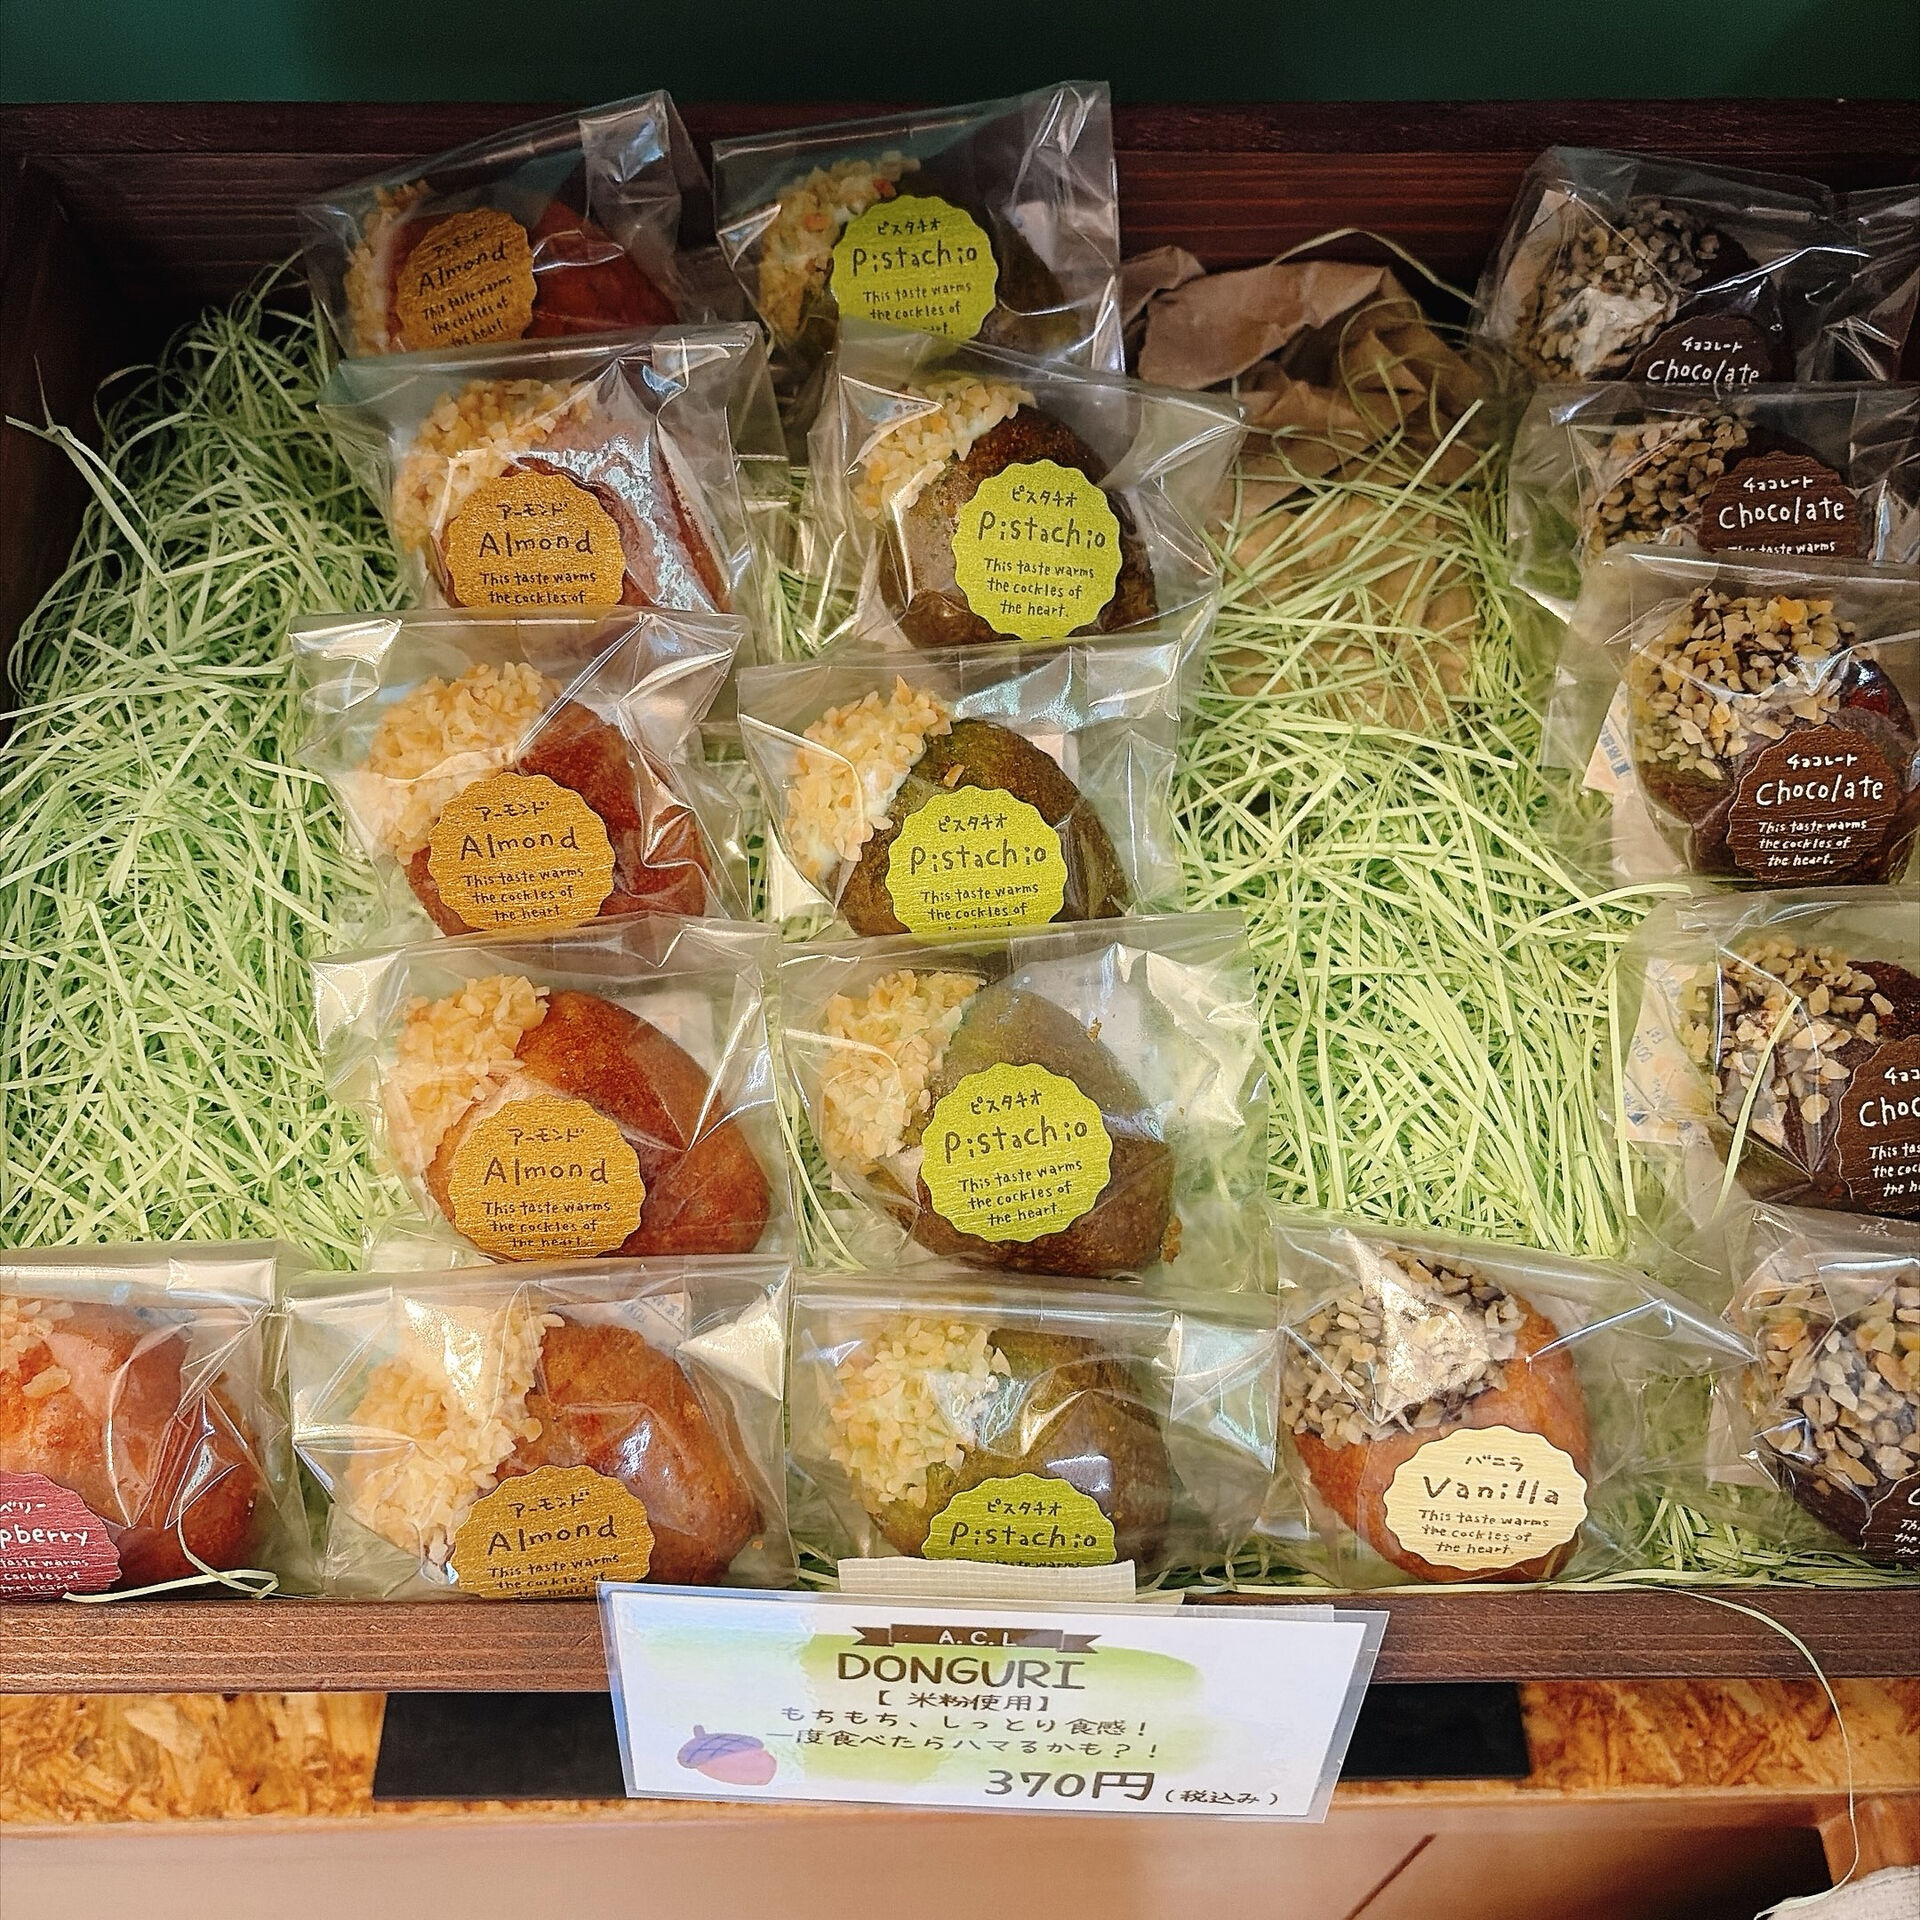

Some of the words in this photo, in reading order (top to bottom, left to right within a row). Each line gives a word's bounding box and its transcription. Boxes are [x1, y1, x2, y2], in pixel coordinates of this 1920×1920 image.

[853, 240, 977, 276] Pistachio
[419, 241, 507, 296] Almond
[863, 291, 890, 304] This
[896, 286, 927, 301] taste
[931, 282, 971, 294] warms
[870, 308, 891, 320] the
[896, 304, 944, 319] cockles
[949, 300, 960, 314] of
[1647, 359, 1760, 384] Chocolate
[1012, 485, 1078, 508] ピスタチオ
[1719, 497, 1846, 529] Chocolate
[978, 511, 1106, 549] Pistachio
[479, 530, 593, 558] Almond
[1796, 541, 1835, 554] warms
[984, 558, 1012, 572] This
[1017, 560, 1050, 576] taste
[1055, 566, 1095, 578] warms
[480, 572, 510, 586] This
[514, 572, 548, 585] taste
[552, 572, 597, 582] warms
[987, 577, 1009, 593] the
[1013, 583, 1063, 598] cockles
[1069, 586, 1082, 599] of
[488, 591, 510, 604] the
[515, 591, 568, 603] cockles
[572, 590, 586, 603] of
[1000, 600, 1022, 614] the
[1028, 603, 1068, 617] heart.
[1787, 754, 1858, 770] チョコレート
[1756, 774, 1884, 806] Chocolate
[475, 801, 550, 821] アーモンド
[939, 813, 1008, 832] ピスタチオ
[1758, 822, 1785, 833] This
[1790, 821, 1823, 833] taste
[1827, 821, 1868, 830] warms
[460, 826, 580, 860] Almond
[1759, 839, 1782, 849] the
[1782, 839, 1831, 848] cockles
[1836, 837, 1851, 849] of
[910, 839, 1047, 875] Pistachio
[1767, 855, 1789, 867] the
[1793, 854, 1834, 865] heart.
[463, 875, 494, 887] This
[500, 871, 535, 885] taste
[540, 868, 584, 880] warms
[472, 892, 496, 904] the
[500, 889, 555, 902] cockles
[560, 885, 574, 898] of
[921, 891, 950, 904] This
[955, 887, 991, 901] taste
[995, 884, 1039, 897] warms
[928, 909, 951, 921] the
[956, 905, 1008, 919] cockles
[1014, 902, 1028, 915] of
[971, 1089, 1043, 1114] ピスタチオ
[507, 1128, 584, 1146] アーモンド
[945, 1115, 1088, 1164] Pistachio
[1869, 1145, 1897, 1160] This
[483, 1157, 609, 1185] Almond
[958, 1179, 990, 1193] This
[994, 1169, 1032, 1187] taste
[1037, 1160, 1082, 1178] warms
[1872, 1165, 1894, 1178] the
[968, 1197, 992, 1210] the
[997, 1187, 1052, 1206] cockles
[1058, 1181, 1072, 1194] of
[1882, 1183, 1904, 1197] the
[481, 1201, 515, 1216] This
[520, 1202, 558, 1215] taste
[563, 1203, 610, 1213] warms
[987, 1214, 1011, 1226] the
[1017, 1203, 1063, 1221] heart.
[490, 1221, 515, 1232] the
[520, 1221, 577, 1232] cockles
[584, 1219, 598, 1231] of
[1465, 1455, 1524, 1472] バニラ
[1424, 1476, 1560, 1505] Vanilla
[508, 1492, 590, 1518] アーモンド
[987, 1498, 1062, 1517] ピスタチオ
[1419, 1509, 1451, 1521] This
[1457, 1512, 1496, 1524] taste
[1501, 1517, 1549, 1527] warms
[487, 1515, 618, 1556] Almond
[950, 1522, 1096, 1548] Pistachio
[1421, 1525, 1446, 1535] the
[1452, 1530, 1510, 1541] cockles
[1515, 1532, 1532, 1543] of
[1436, 1542, 1460, 1552] the
[1467, 1544, 1514, 1554] heart.
[4, 1572, 63, 1581] cockles
[66, 1571, 81, 1580] of
[488, 1567, 522, 1578] This
[528, 1560, 566, 1575] taste
[571, 1555, 619, 1569] warms
[837, 1652, 1086, 1691] DONGURI
[984, 1769, 1155, 1800] 370円
